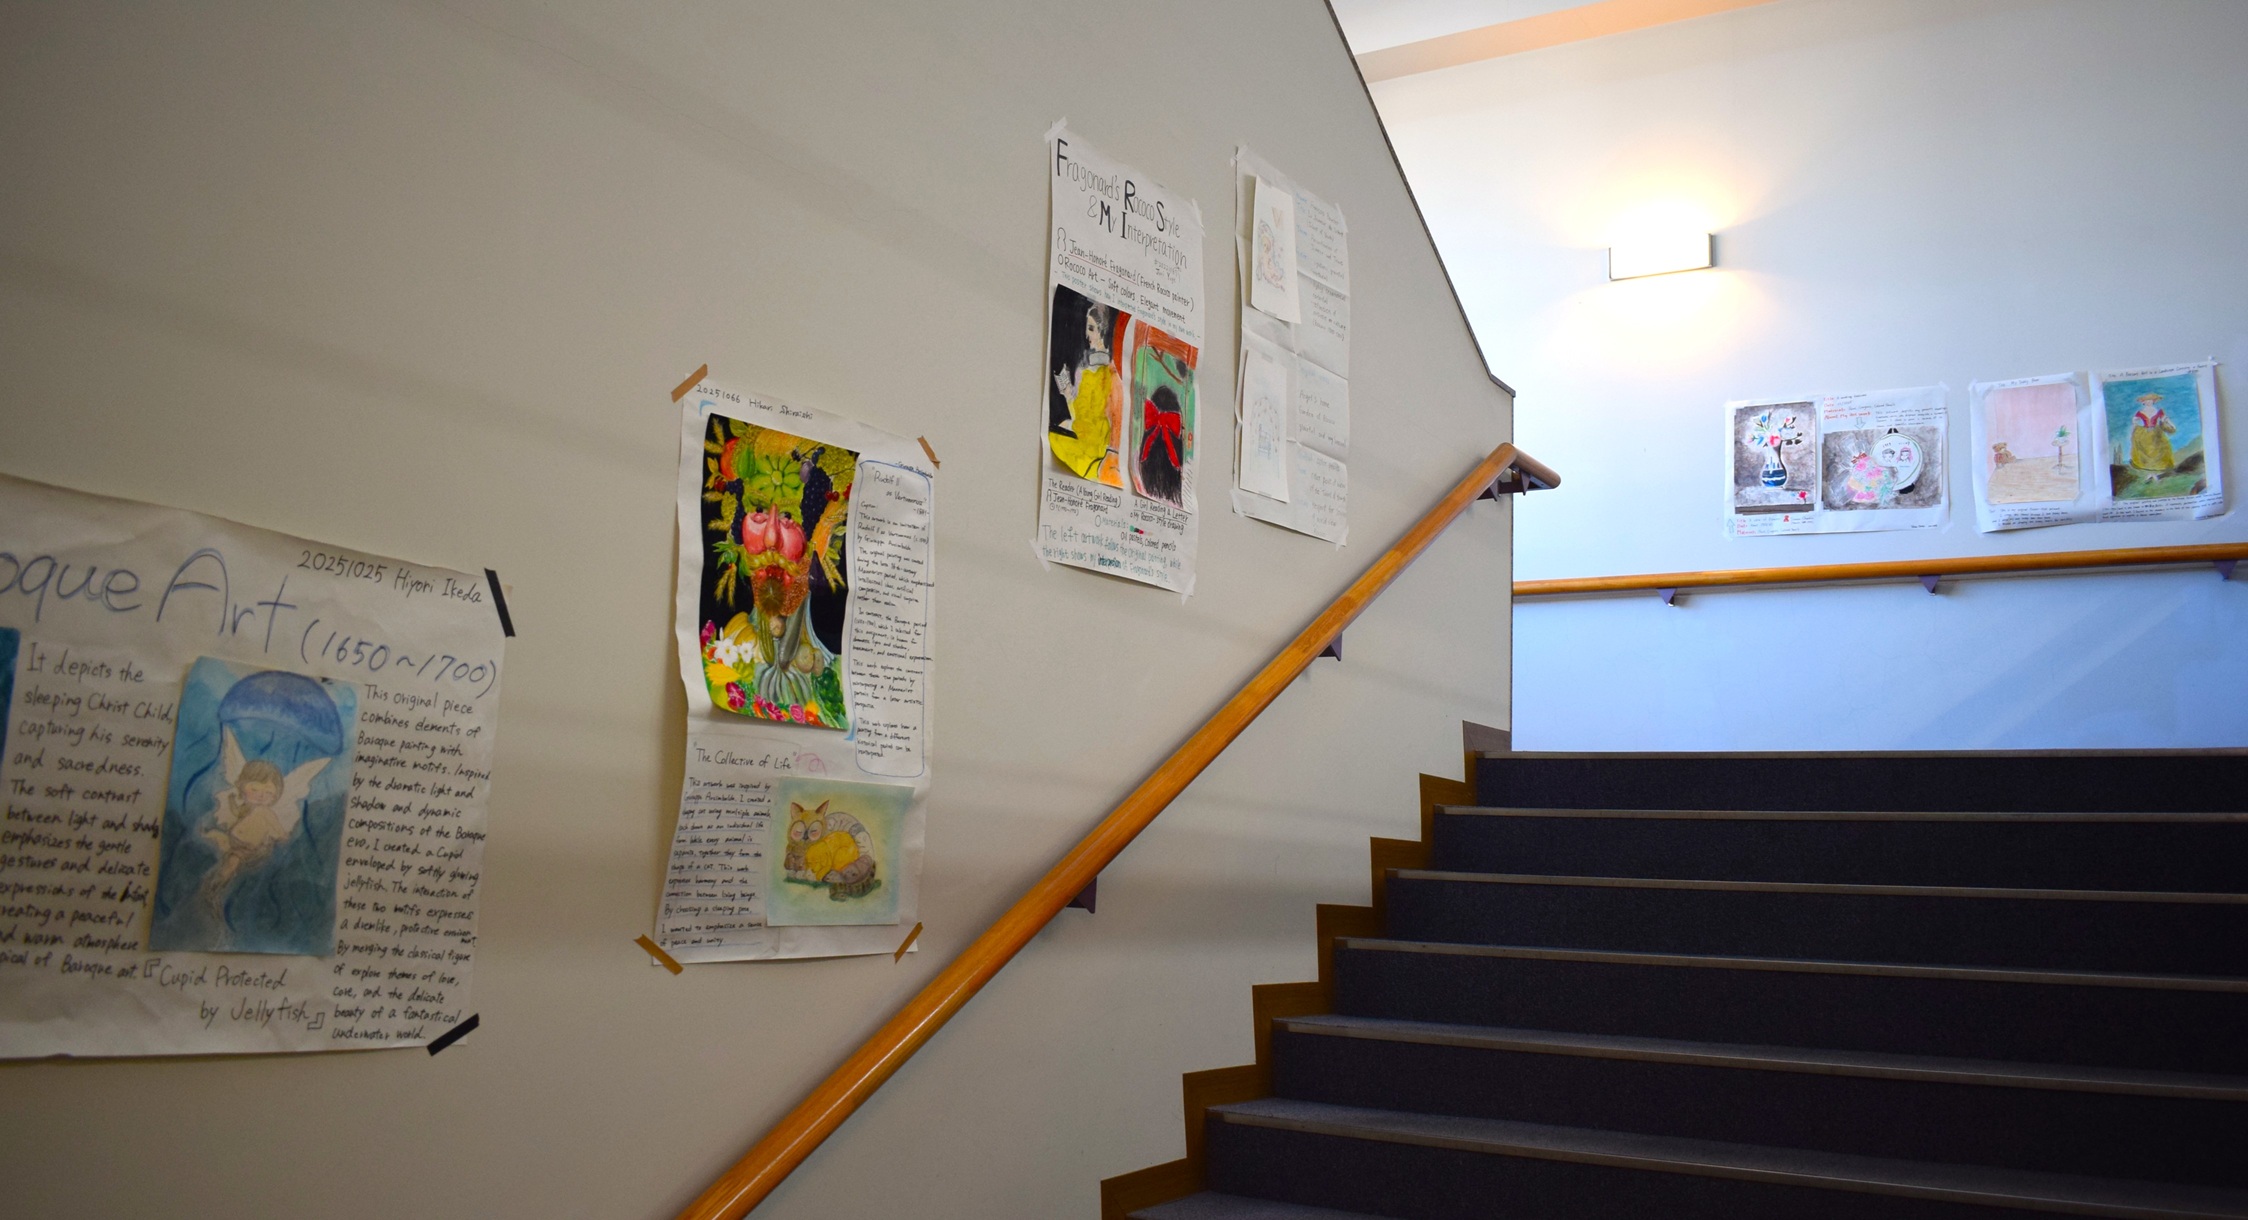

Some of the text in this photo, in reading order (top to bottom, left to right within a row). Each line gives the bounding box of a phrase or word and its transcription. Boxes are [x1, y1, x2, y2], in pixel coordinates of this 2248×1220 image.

[1056, 138, 1181, 238] Fragonard's Rococo Style
[1099, 200, 1117, 234] My
[1119, 211, 1188, 270] Interpretation
[297, 549, 482, 603] 20251025 Hiyori Ikeda
[155, 547, 298, 654] Art
[26, 642, 145, 684] It depicts the
[25, 684, 83, 718] sleeping
[87, 691, 130, 715] Christ
[364, 683, 389, 701] This
[442, 700, 475, 718] piece
[18, 719, 86, 748] capturing
[89, 723, 113, 744] his
[360, 709, 482, 740] combines elements of
[357, 729, 464, 759] Baroque painting with
[13, 747, 45, 769] and
[354, 751, 408, 769] imaginative
[11, 778, 143, 805] The soft contrast
[352, 771, 475, 800] by the dramatic light and
[6, 804, 129, 833] between light and
[392, 801, 463, 821] and dynamic
[1, 827, 132, 857] emphasizes the gentle
[420, 825, 433, 837] of
[436, 826, 451, 840] the
[373, 838, 464, 863] I created a Cupid
[60, 856, 91, 874] and
[98, 860, 151, 878] delicate
[345, 855, 396, 872] enveloped
[401, 860, 413, 877] by
[79, 883, 97, 899] of
[344, 895, 367, 911] these
[392, 881, 408, 895] The
[461, 887, 475, 902] of
[54, 908, 66, 922] a
[69, 909, 135, 930] peaceful
[339, 918, 349, 930] a
[399, 922, 440, 938] protective
[72, 931, 140, 956] atmosphere
[336, 938, 472, 966] By merging the classical figure
[34, 950, 53, 968] of
[60, 952, 113, 981] Baroque
[215, 964, 289, 991] Protected
[333, 962, 346, 976] of
[422, 970, 437, 982] of
[363, 985, 383, 999] and
[388, 985, 404, 1001] the
[407, 985, 446, 1005] delicate
[200, 1000, 220, 1031] by
[333, 1004, 462, 1025] beauty of a fantastical
[331, 1026, 391, 1040] underwater
